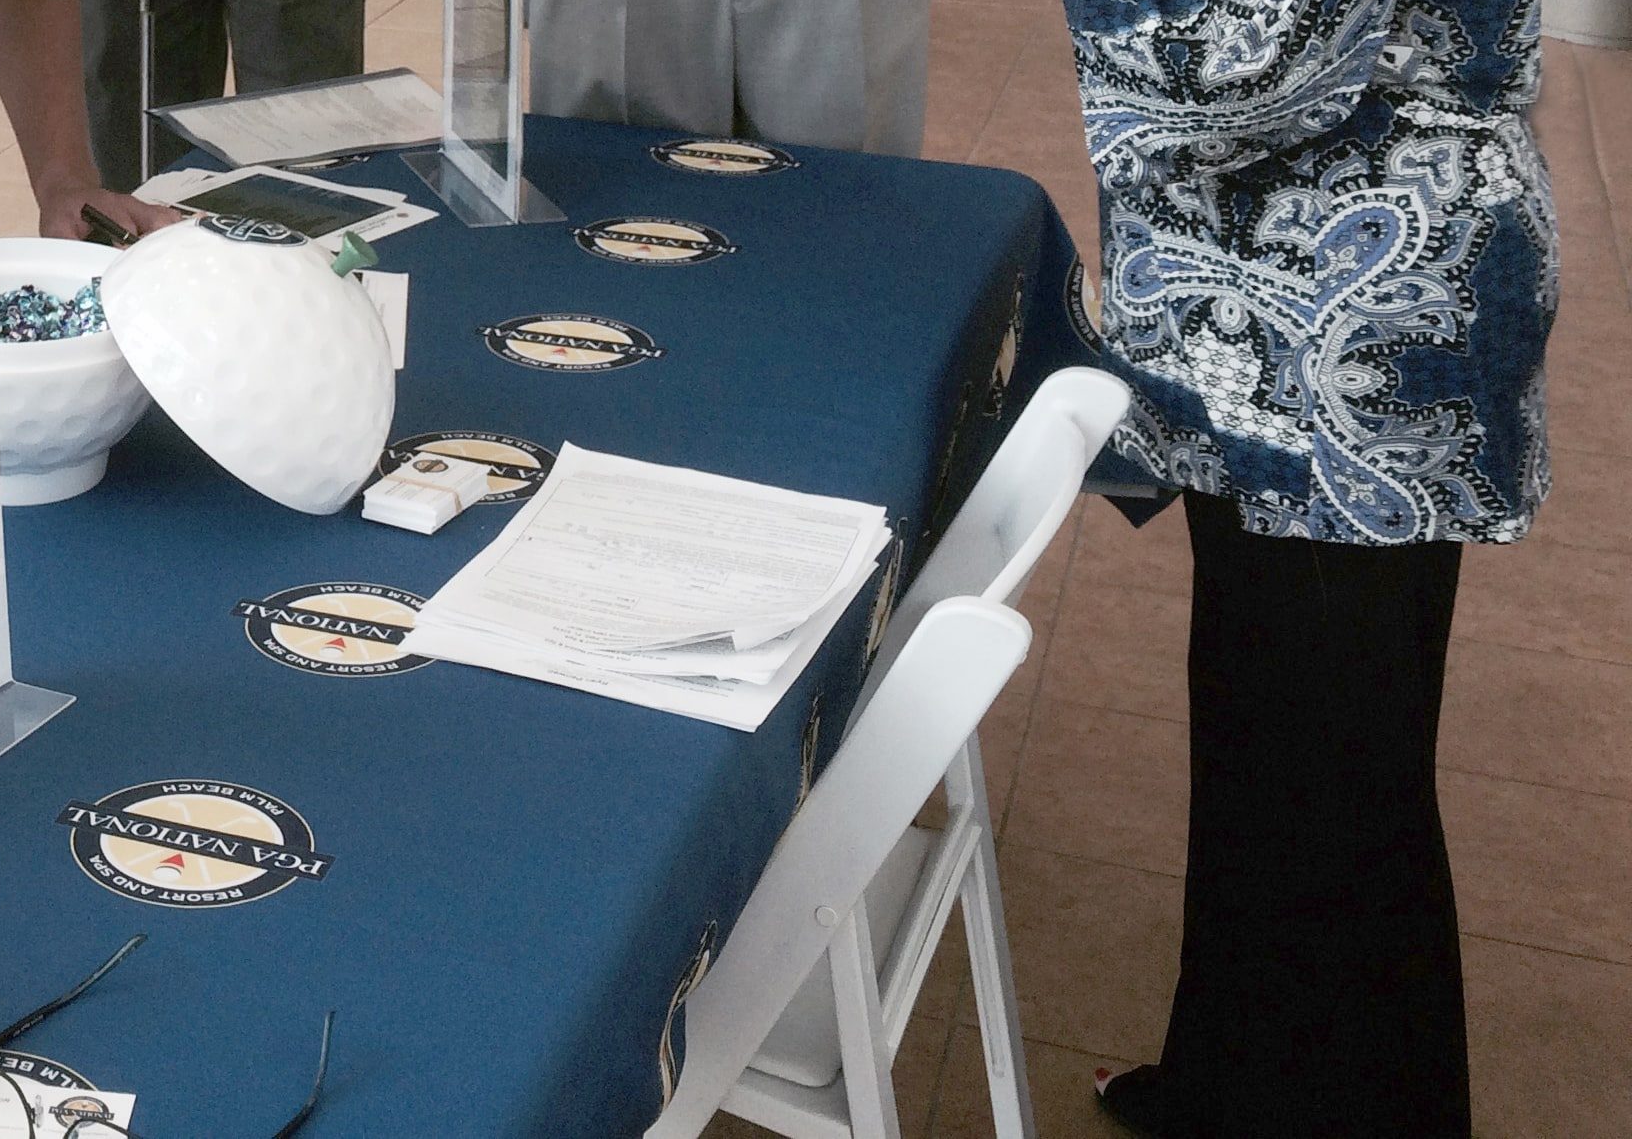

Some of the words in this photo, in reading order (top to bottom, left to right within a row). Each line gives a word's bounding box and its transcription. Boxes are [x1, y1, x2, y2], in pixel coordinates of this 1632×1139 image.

[481, 326, 601, 351] NATIONAL
[320, 585, 383, 596] BEACH
[240, 602, 392, 640] NATIONAL
[285, 653, 323, 671] AND
[325, 661, 400, 673] RESORT
[161, 783, 235, 798] BEACH
[240, 790, 285, 817] PALM
[68, 806, 243, 857] NATIONAL
[88, 853, 117, 879] SPA
[251, 845, 328, 877] PGA
[112, 874, 155, 896] AND
[157, 887, 244, 903] RESORT
